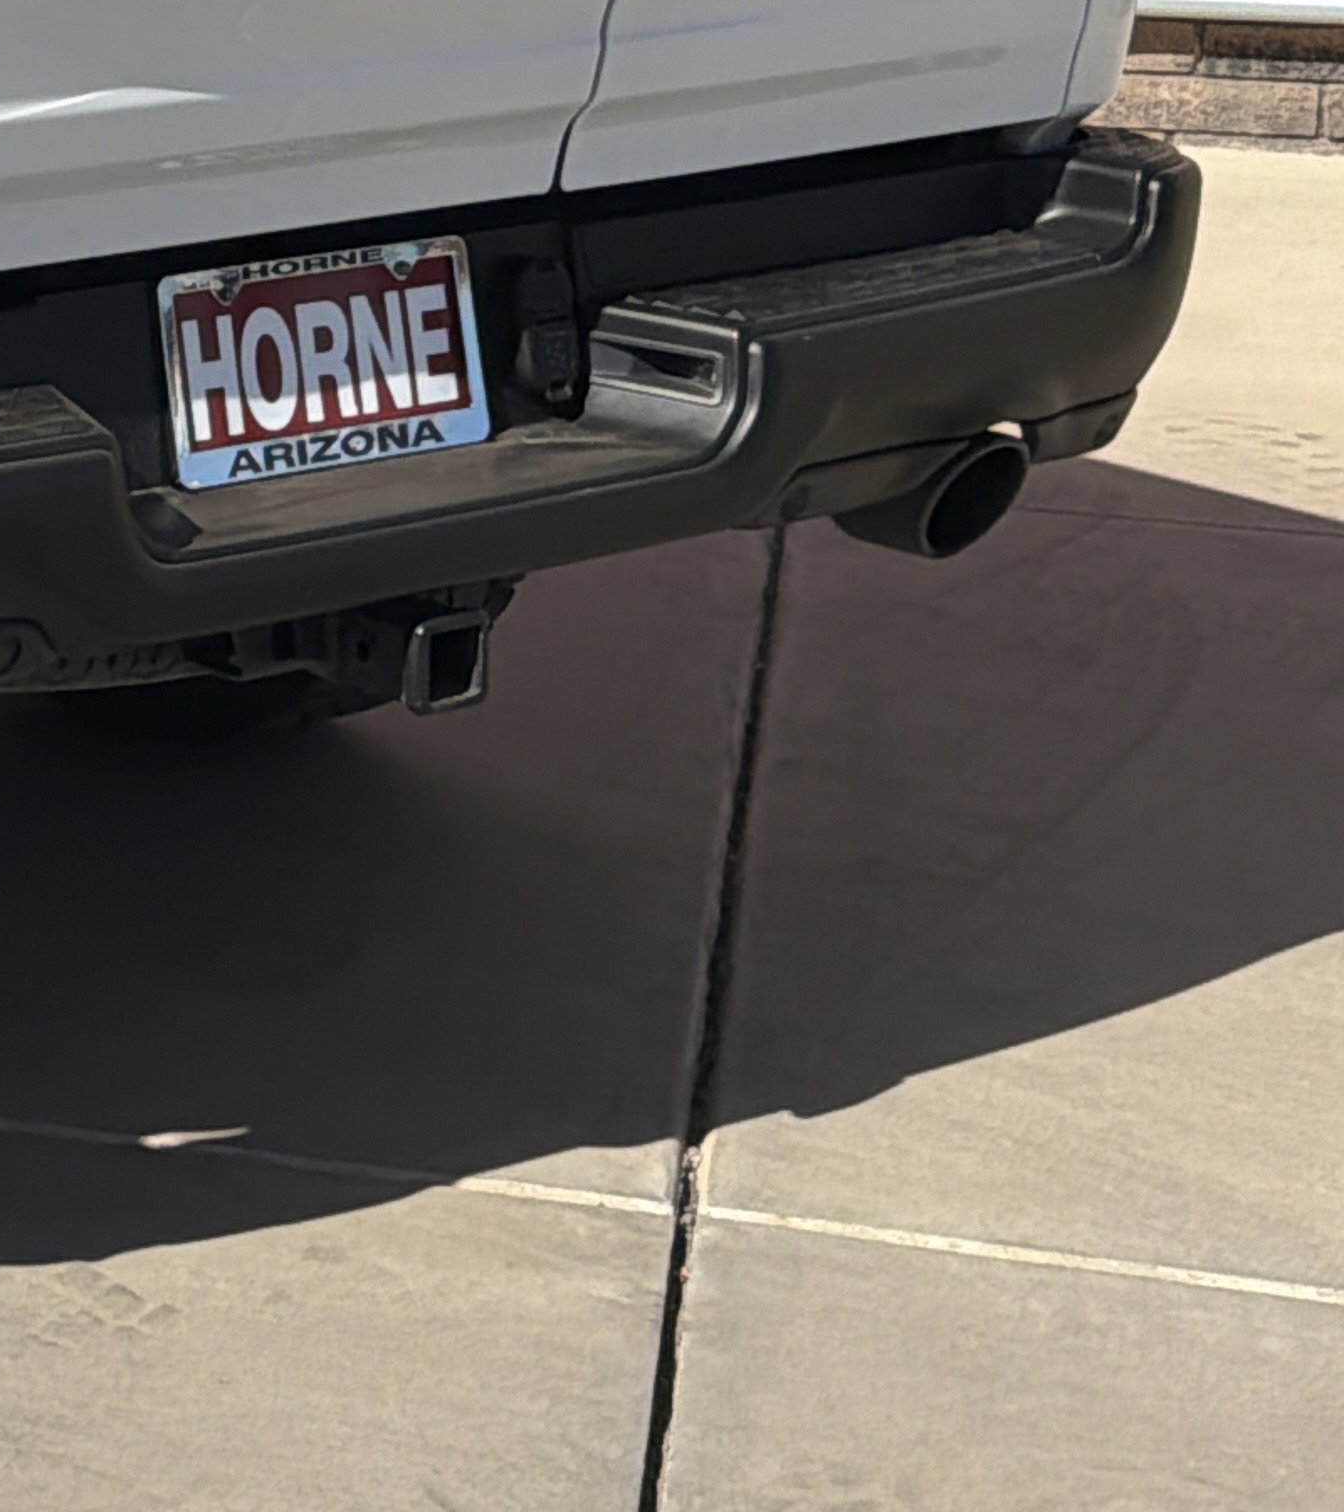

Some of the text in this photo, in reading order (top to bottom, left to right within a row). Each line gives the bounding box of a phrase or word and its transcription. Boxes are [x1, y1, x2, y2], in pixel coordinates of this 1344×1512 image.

[242, 248, 383, 280] HORNE
[181, 284, 458, 442] HORNE
[228, 420, 444, 477] ARIZONA
